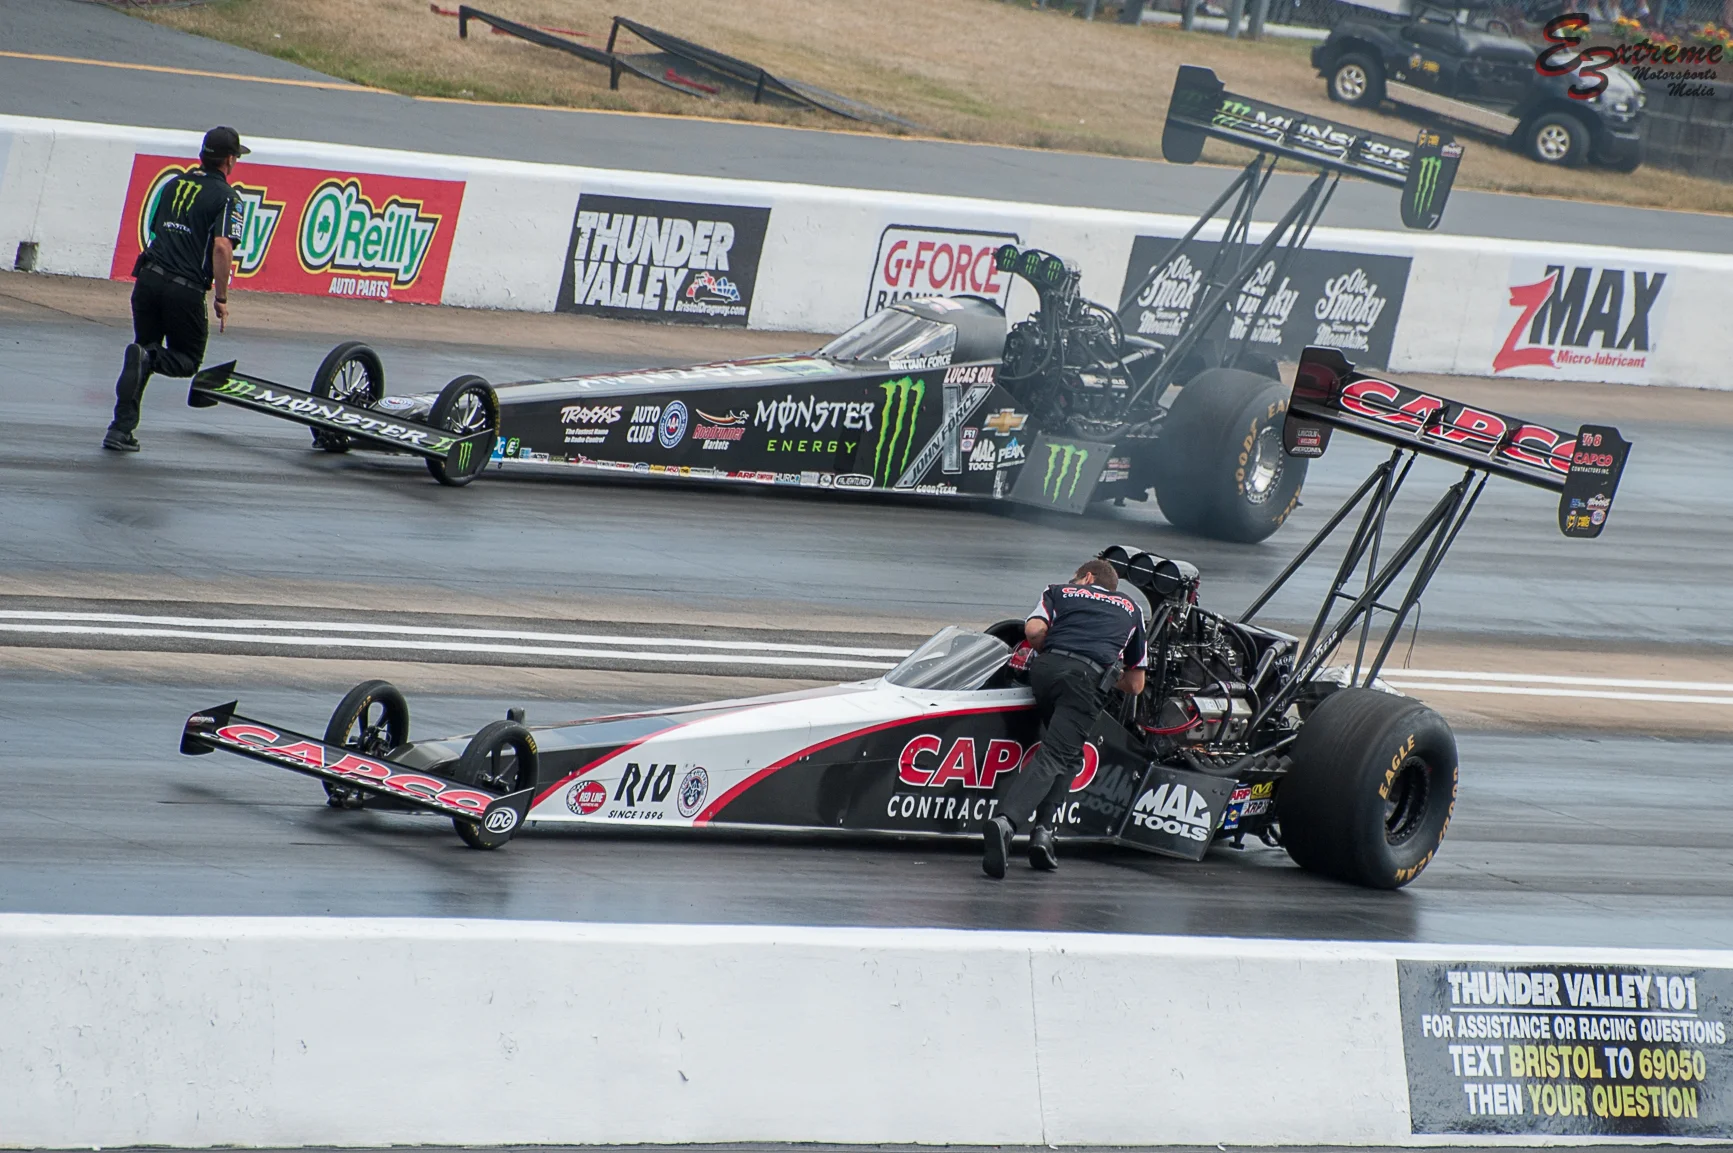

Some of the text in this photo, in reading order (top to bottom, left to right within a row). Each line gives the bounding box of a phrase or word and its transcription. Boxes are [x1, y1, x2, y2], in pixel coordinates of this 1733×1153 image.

[305, 190, 430, 276] O'Reilly
[1427, 213, 1439, 229] 7
[574, 210, 736, 272] THUNDER
[883, 240, 1001, 294] G-FORCE
[328, 276, 389, 298] AUTO PARTS
[573, 259, 690, 312] VALLEY
[1137, 262, 1204, 311] Smok
[675, 301, 747, 317] BristolDragway.com
[1314, 273, 1387, 333] Smoky
[927, 353, 952, 367] FORCE
[1556, 349, 1647, 369] Micro-lubricant
[943, 366, 995, 384] LUCAS OIL
[560, 405, 623, 425] TRAXXAS
[630, 405, 661, 424] AUTO
[940, 389, 977, 441] FORCE
[626, 424, 655, 443] CLUB
[692, 424, 746, 442] Roadrunner
[766, 439, 857, 454] ENERGY
[969, 438, 996, 463] MAC
[997, 444, 1026, 463] PEAK
[909, 439, 941, 484] JOHN
[968, 461, 995, 471] TOOLS
[1573, 452, 1613, 467] CAPCO
[736, 471, 756, 479] ARP
[916, 483, 957, 495] GOODYEAR
[1062, 587, 1135, 613] CAPCO
[215, 723, 494, 815] CAPCO
[1378, 734, 1415, 801] EAGLE
[613, 762, 677, 808] RIO
[1231, 788, 1250, 801] ARP
[608, 809, 664, 820] SINCE 1896
[886, 794, 1081, 824] CONTRACT NC.
[1134, 782, 1212, 827] MAC
[488, 814, 514, 829] IDG
[1132, 812, 1209, 843] TOOLS
[1447, 970, 1697, 1010] THUNDER VALLEY 101
[1422, 1014, 1726, 1045] FOR ASSISTANCE OR RACING QUESTIONS
[1448, 1045, 1706, 1082] TEXT BRISTOL TO 69050
[1464, 1083, 1698, 1119] THEN YOUR QUESTION
